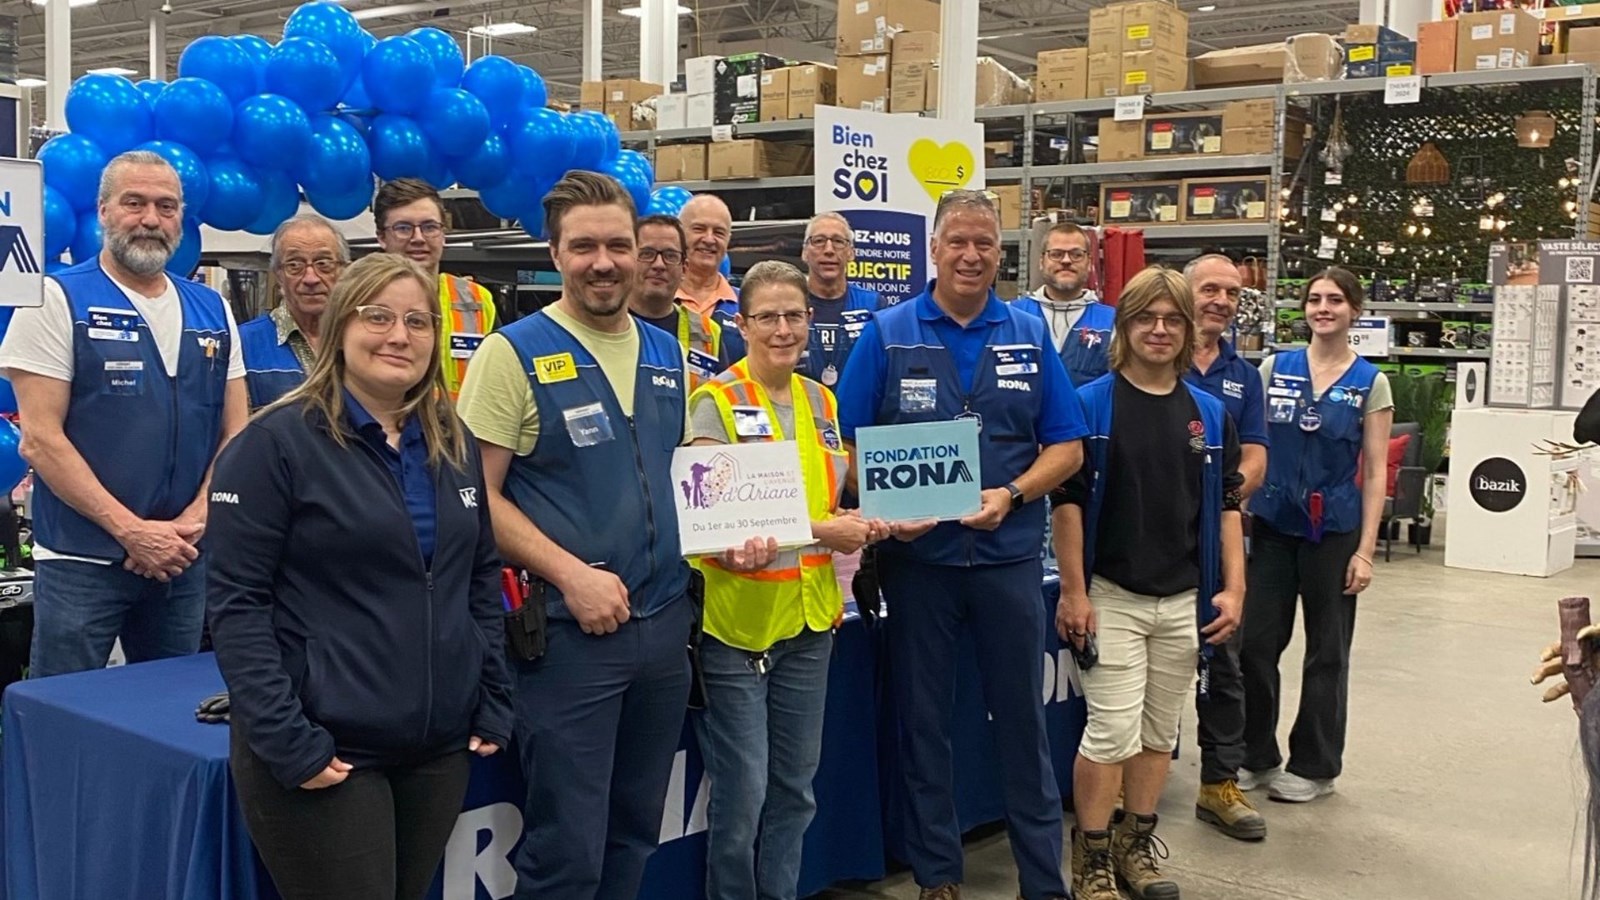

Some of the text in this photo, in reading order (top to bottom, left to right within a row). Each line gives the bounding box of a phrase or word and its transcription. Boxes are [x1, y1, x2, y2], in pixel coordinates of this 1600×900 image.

[832, 124, 873, 148] Bien
[843, 149, 888, 170] chez
[956, 165, 964, 180] $
[832, 168, 888, 203] SOI
[854, 229, 911, 246] EZ-NOUS
[853, 247, 911, 260] TEINDRE NOTRE
[1541, 242, 1570, 251] VASTE
[845, 261, 912, 280] BJECTIF
[877, 283, 898, 293] DON
[899, 284, 911, 294] DE
[543, 360, 566, 372] VIP
[997, 379, 1031, 391] RONA
[864, 444, 959, 464] FONDATION
[757, 471, 785, 479] MAISON
[866, 460, 974, 491] RONA
[1480, 477, 1521, 493] bazik
[692, 516, 798, 532] Du 1er au 30 Septembre
